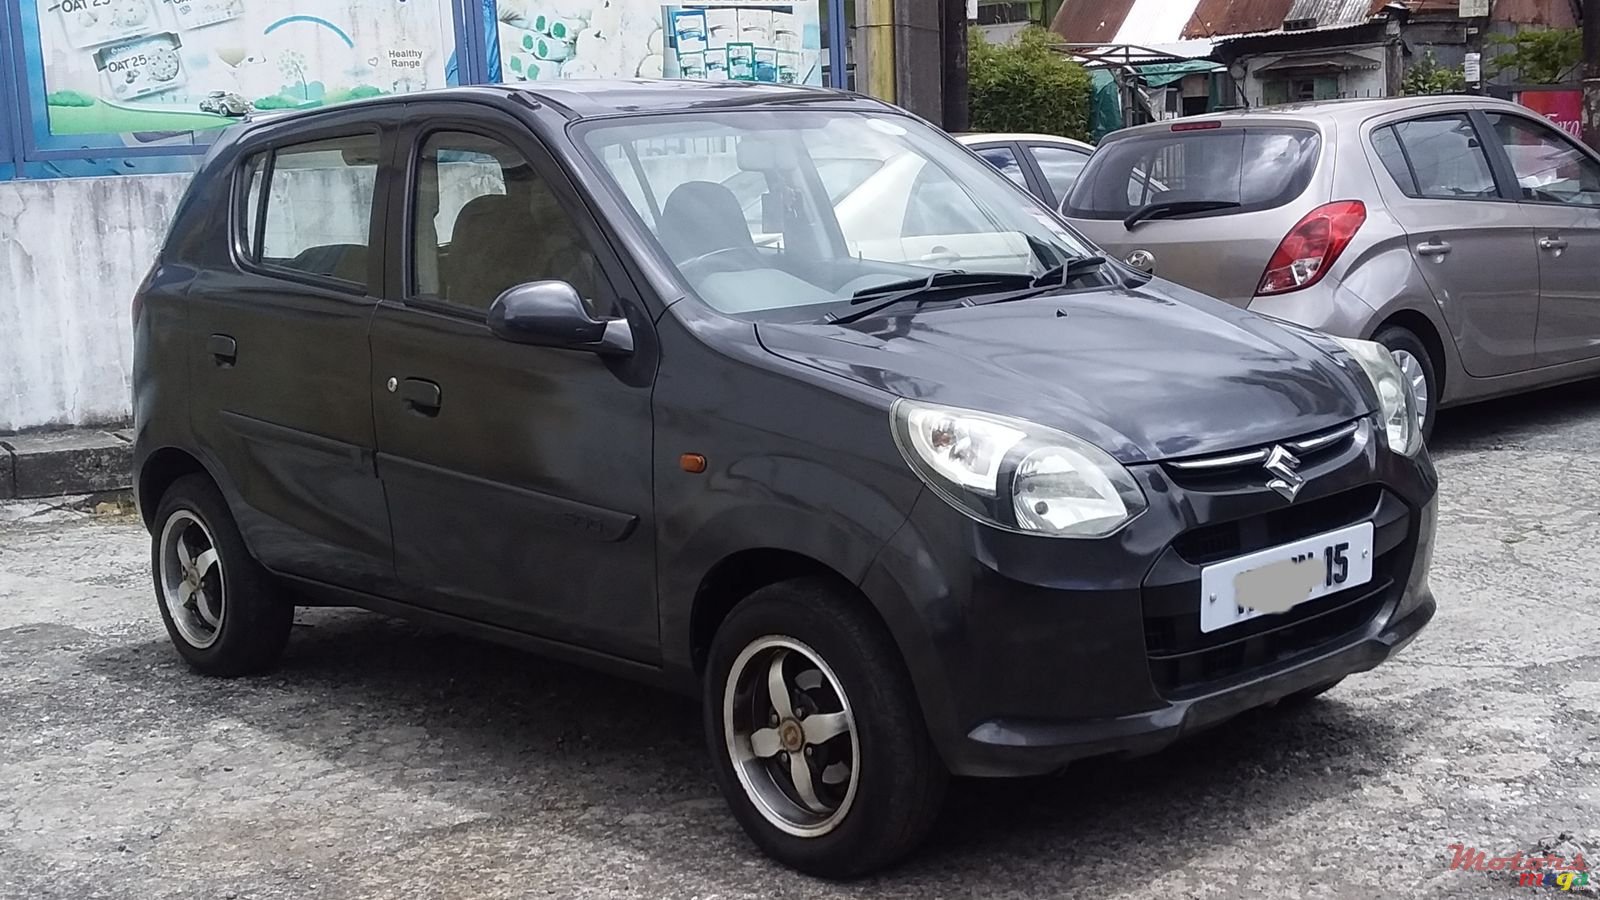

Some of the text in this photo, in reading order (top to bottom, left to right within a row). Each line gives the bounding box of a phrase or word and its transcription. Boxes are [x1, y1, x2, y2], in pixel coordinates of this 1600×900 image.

[61, 0, 87, 12] OAT
[388, 50, 423, 59] Healthy
[108, 54, 147, 72] OAT 25
[391, 59, 421, 68] Range
[1324, 542, 1349, 587] 15
